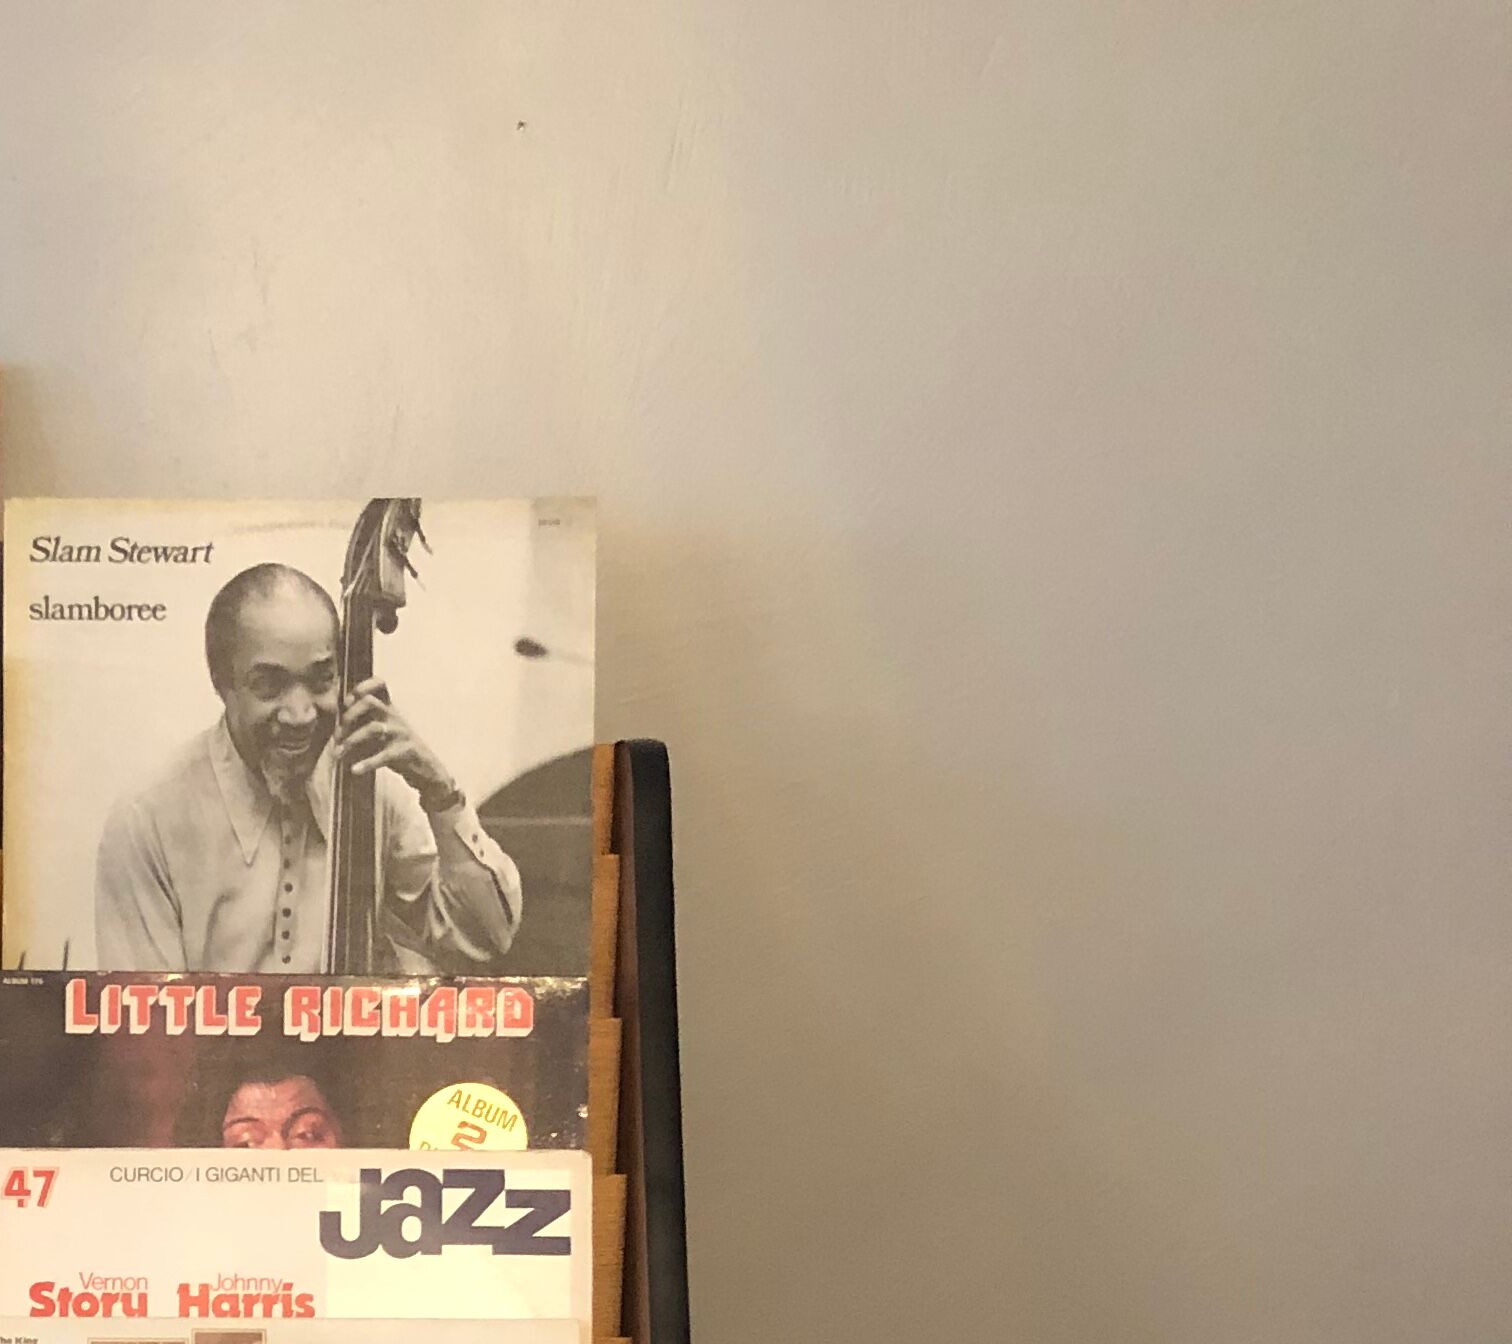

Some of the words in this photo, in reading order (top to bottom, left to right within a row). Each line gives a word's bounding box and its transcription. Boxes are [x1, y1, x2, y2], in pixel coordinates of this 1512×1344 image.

[29, 536, 101, 564] Slam
[108, 536, 214, 564] Stewart
[29, 596, 167, 622] slamboree
[65, 978, 262, 1036] LITTLE
[284, 984, 535, 1042] RICHARD
[447, 1088, 519, 1133] ALBUM
[450, 1120, 488, 1150] 2
[1, 1166, 60, 1209] 47
[109, 1166, 184, 1184] CURCIO
[205, 1166, 282, 1184] GIGANTI
[287, 1167, 324, 1184] DEL
[79, 1271, 148, 1291] Vernon
[210, 1273, 284, 1293] Johnny
[177, 1282, 316, 1318] Harris
